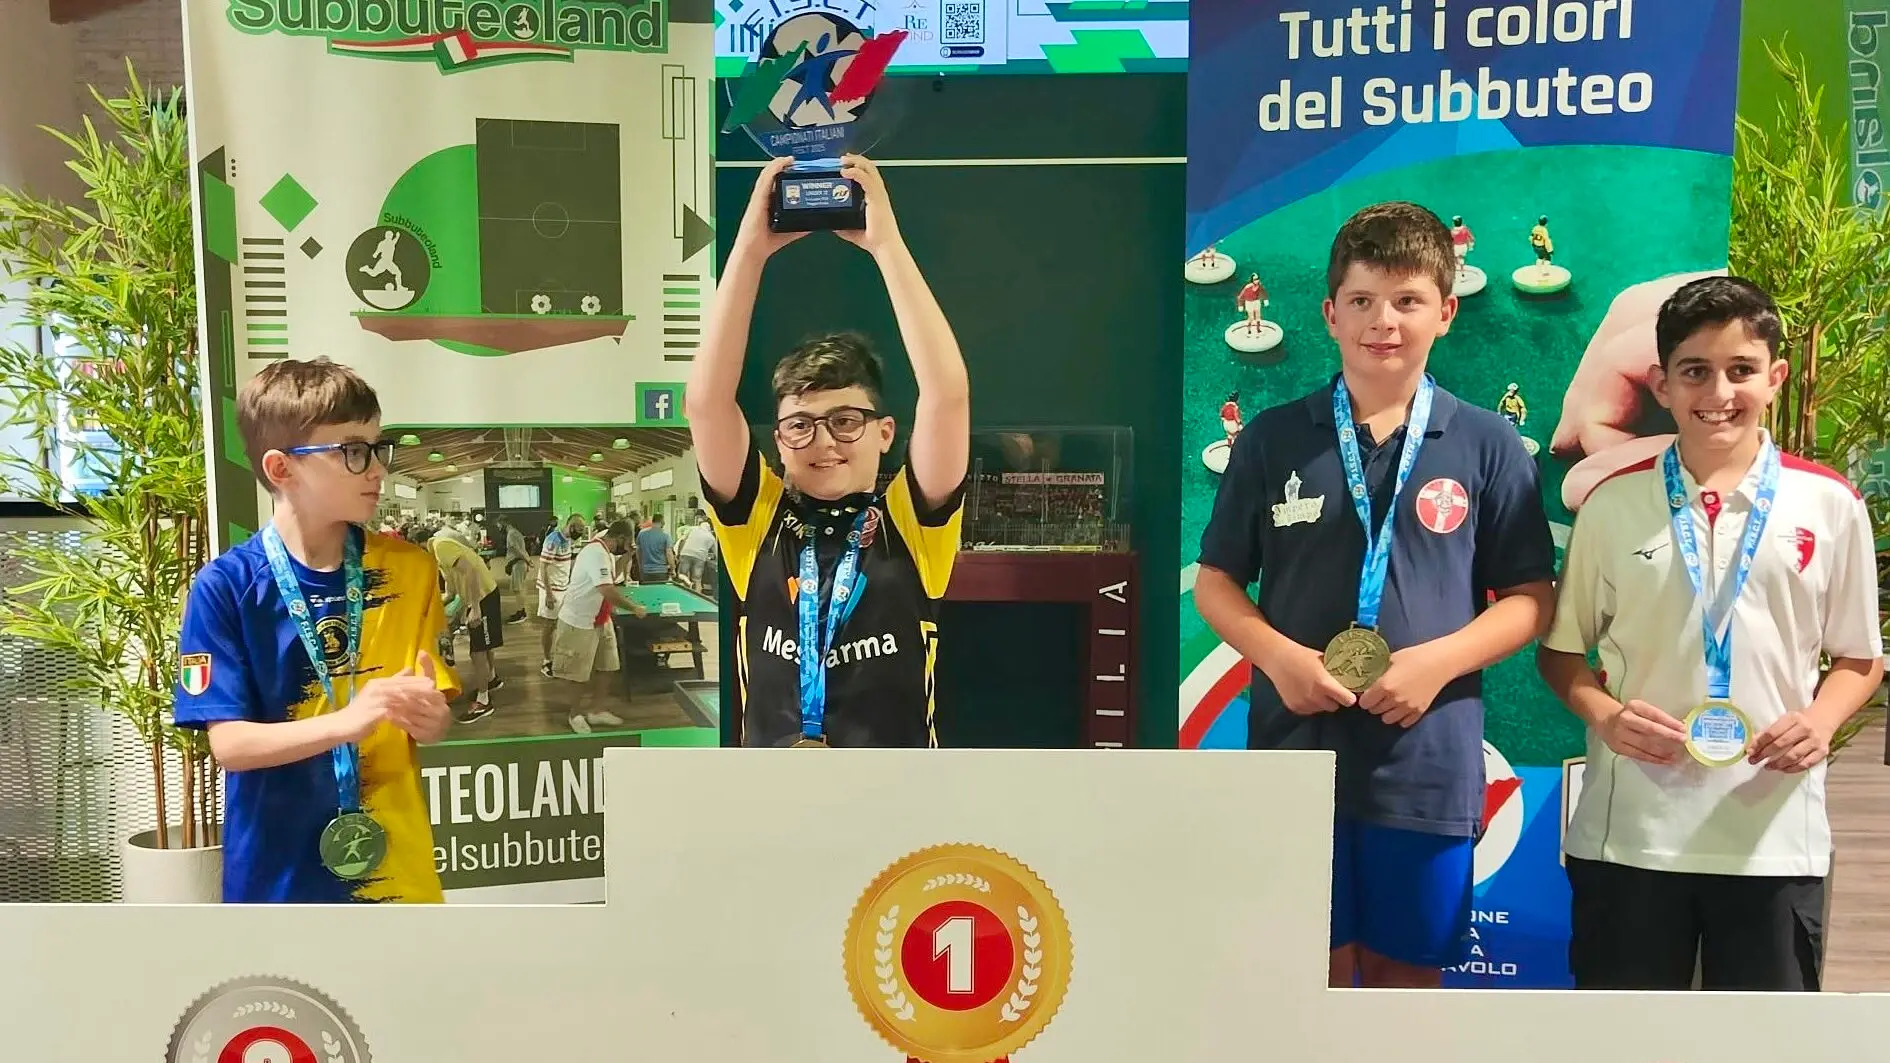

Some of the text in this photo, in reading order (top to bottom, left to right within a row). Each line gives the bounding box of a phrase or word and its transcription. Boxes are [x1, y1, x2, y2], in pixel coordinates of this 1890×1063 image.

[232, 0, 663, 48] Subbuteoland
[908, 31, 934, 41] IND
[1279, 0, 1632, 60] Tutti i colori
[1258, 67, 1653, 132] del Subbuteo
[384, 212, 442, 269] Subbuteoland
[1055, 474, 1103, 483] GRANATA
[762, 625, 898, 669] Mearma
[1095, 580, 1128, 747] ILIA
[933, 916, 975, 994] 1
[1440, 961, 1517, 977] VOLO
